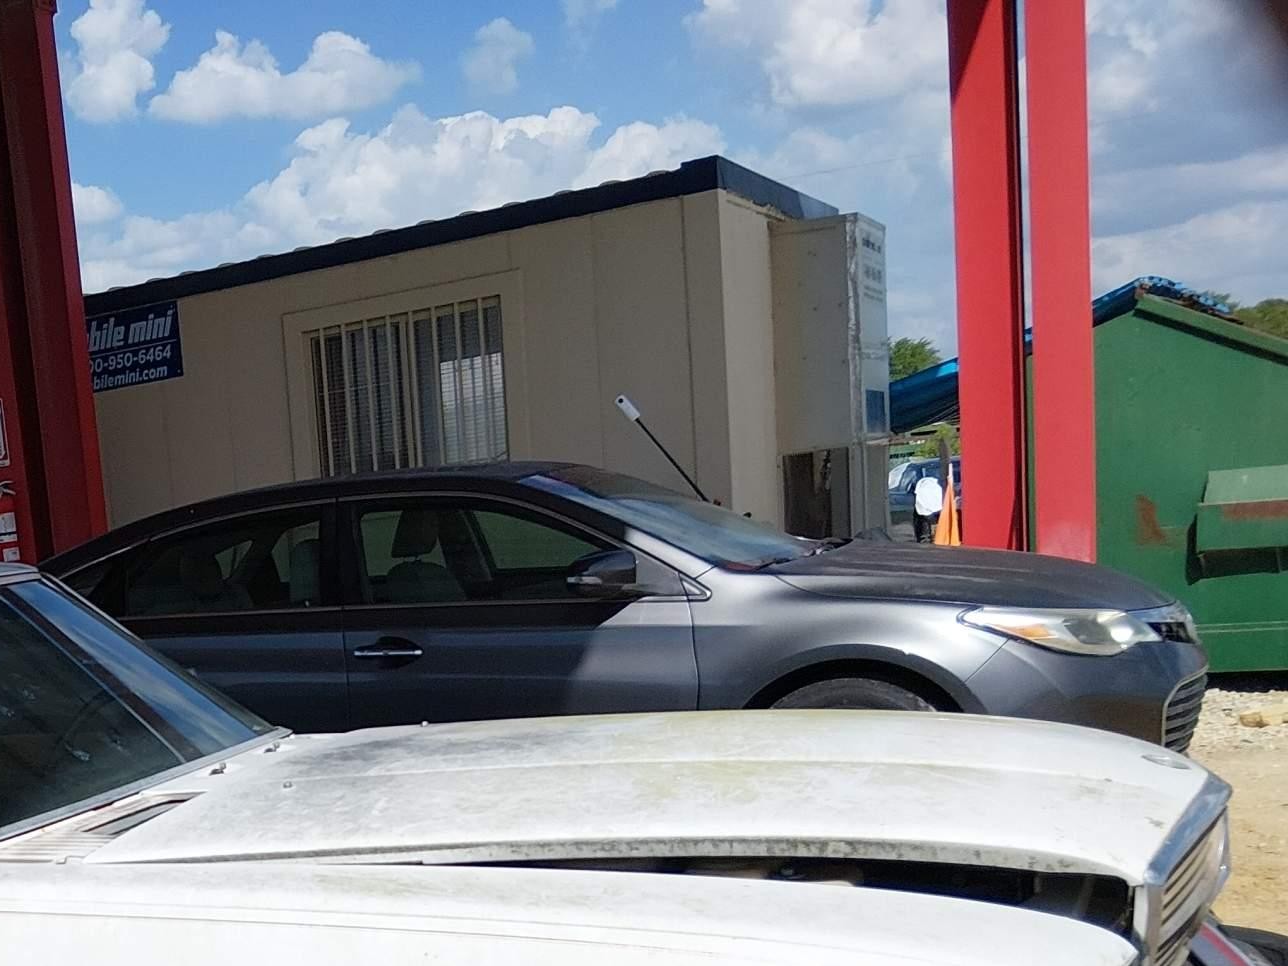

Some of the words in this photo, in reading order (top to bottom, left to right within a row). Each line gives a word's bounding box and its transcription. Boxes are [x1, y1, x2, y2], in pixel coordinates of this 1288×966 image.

[87, 317, 125, 352] bile
[128, 310, 173, 344] mini
[93, 366, 168, 390] bilemini.com
